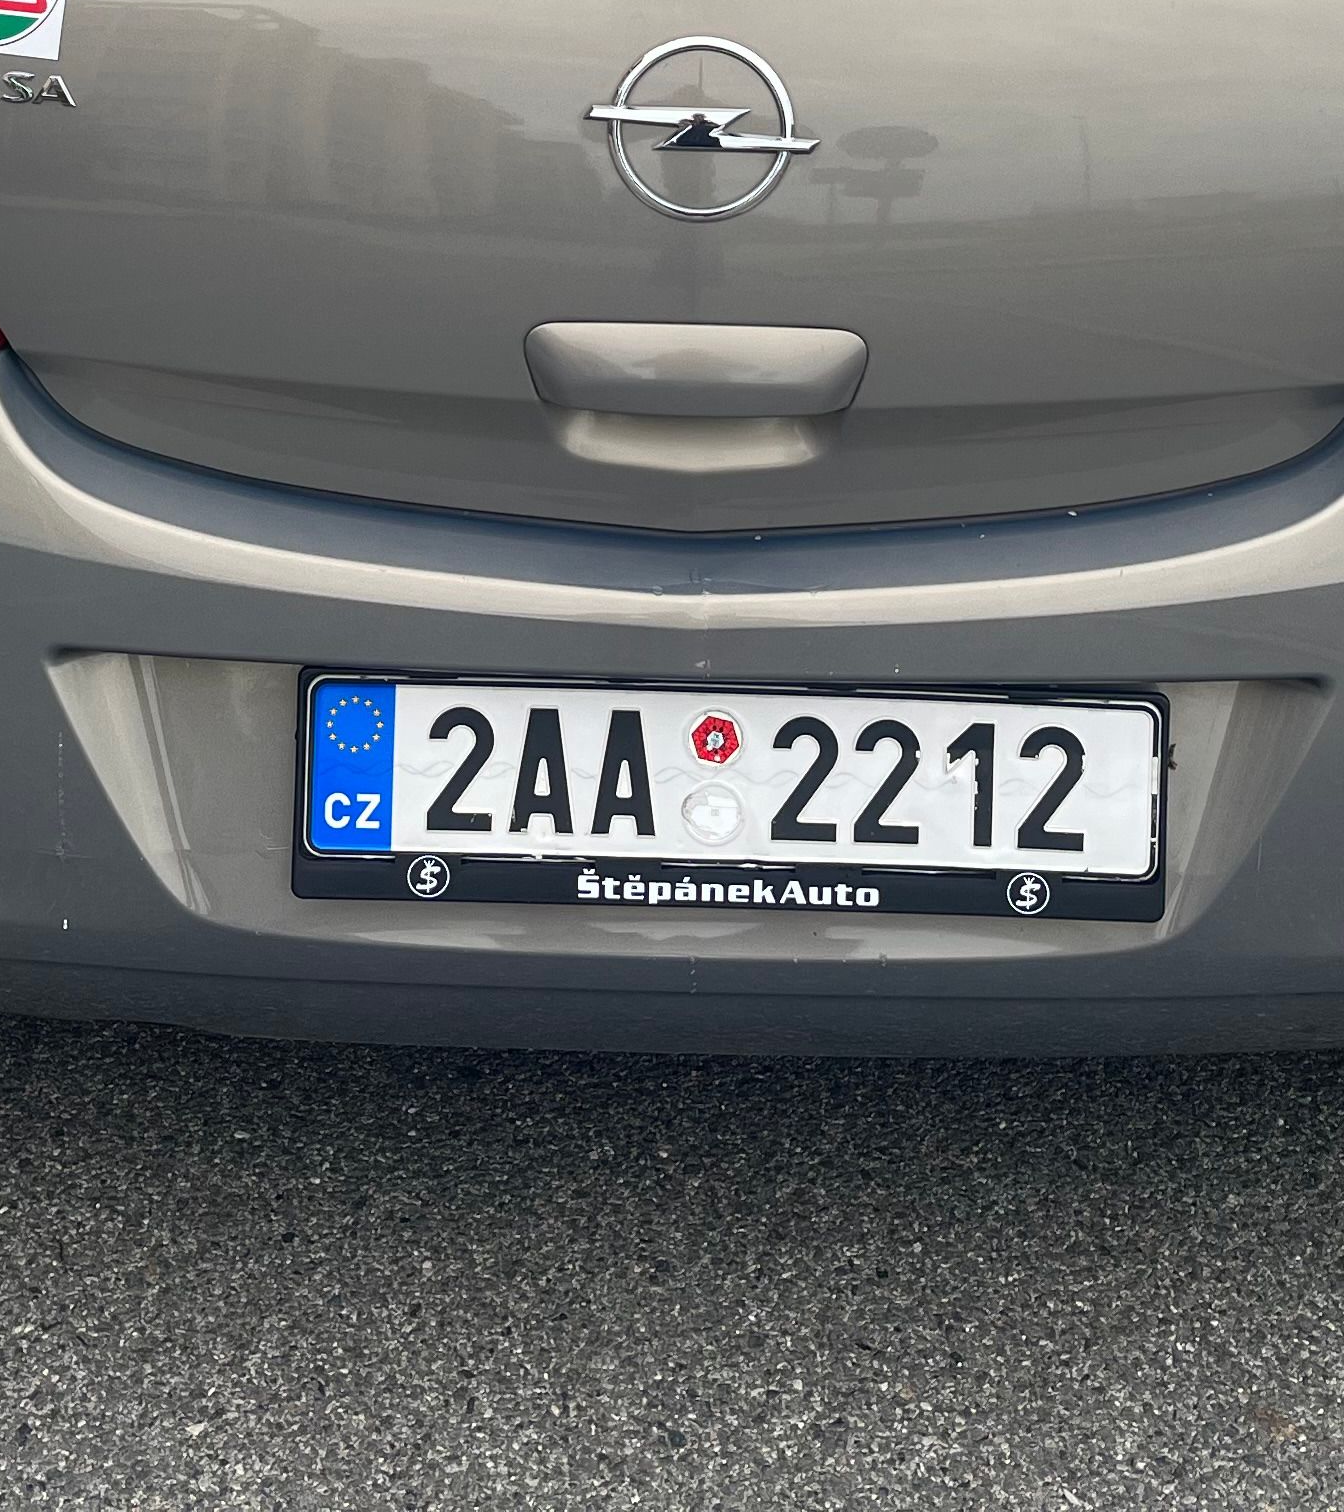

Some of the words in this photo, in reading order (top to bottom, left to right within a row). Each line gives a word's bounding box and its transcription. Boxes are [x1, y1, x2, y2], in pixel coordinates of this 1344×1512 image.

[324, 792, 381, 829] CZ
[426, 706, 656, 837] 2AA
[770, 716, 1086, 852] 2212
